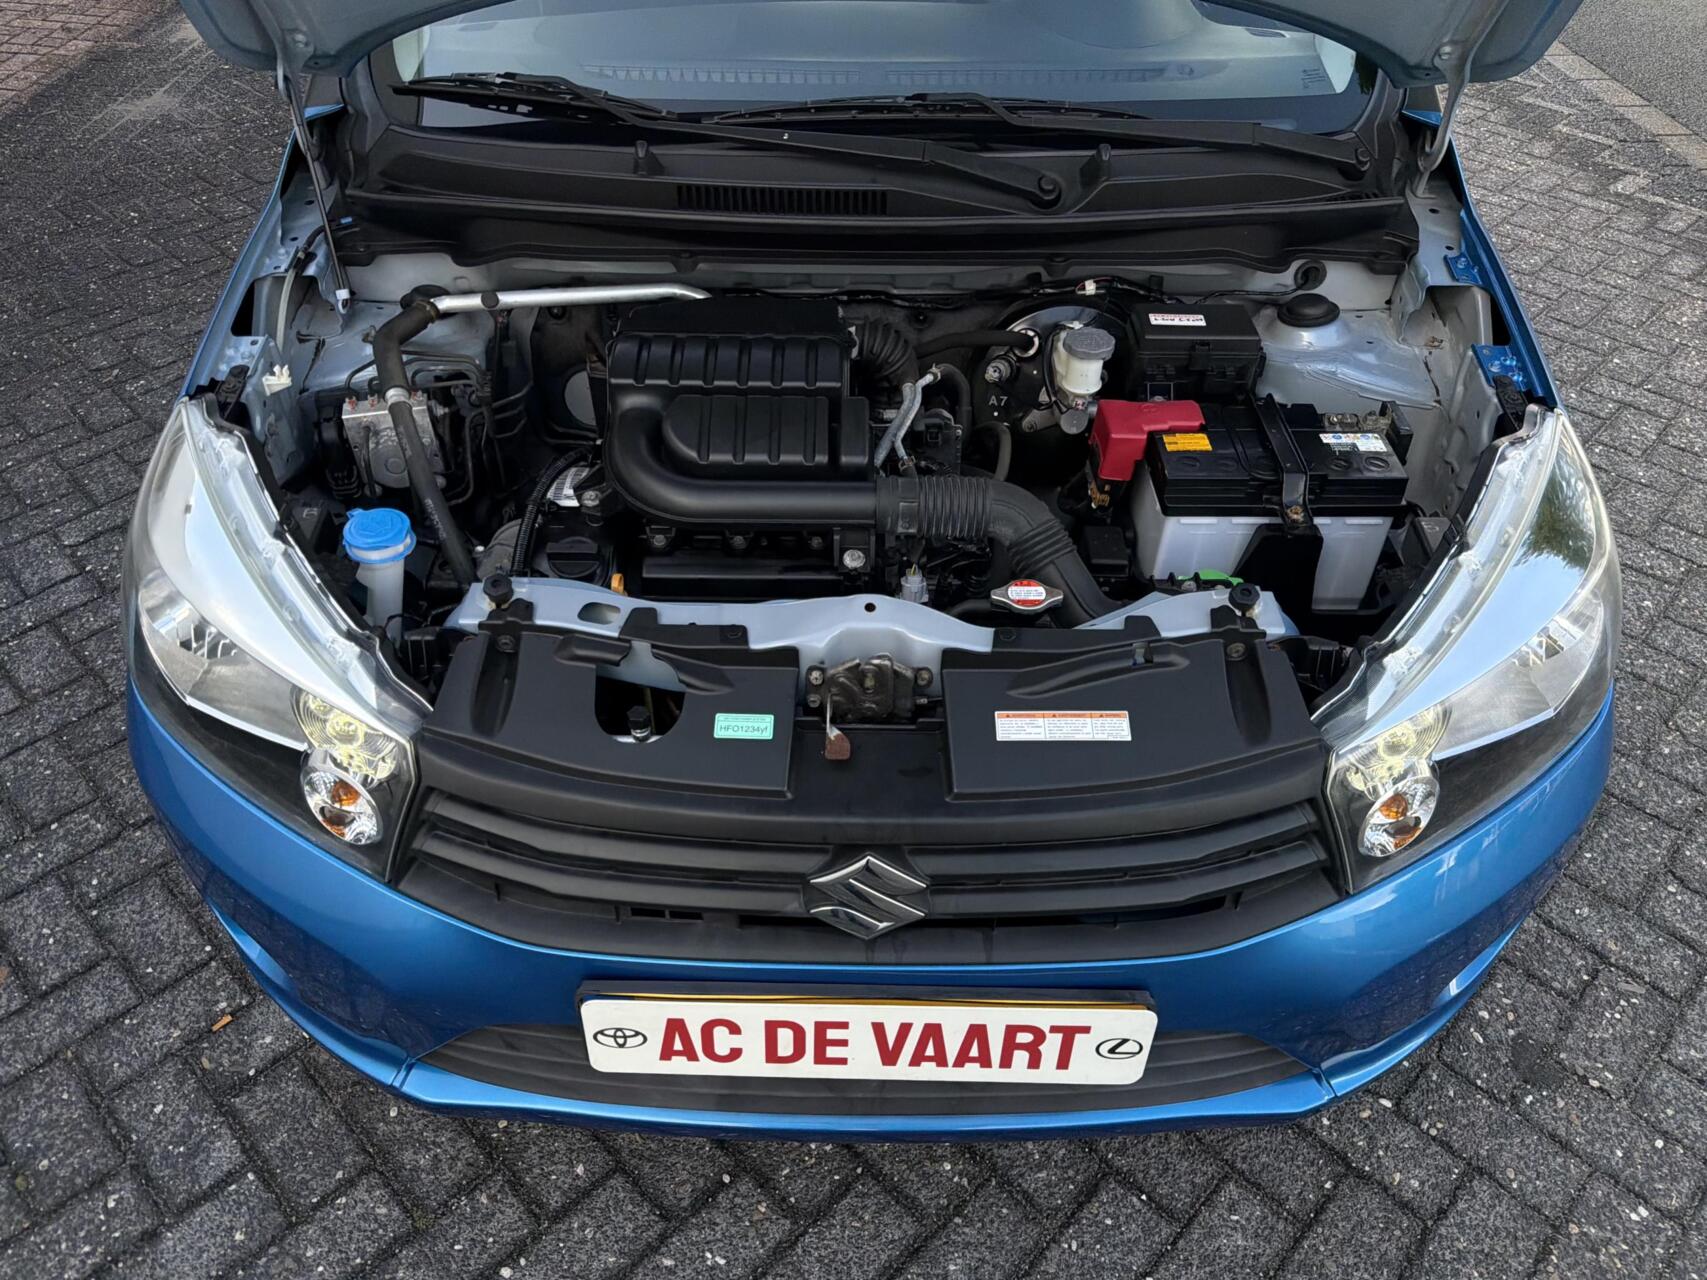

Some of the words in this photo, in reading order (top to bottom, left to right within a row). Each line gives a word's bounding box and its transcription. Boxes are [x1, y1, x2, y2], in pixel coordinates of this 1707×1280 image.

[719, 724, 769, 735] HFO1234yf
[659, 1017, 743, 1064] AC
[763, 1019, 849, 1066] DE
[871, 1021, 1093, 1071] VAART
